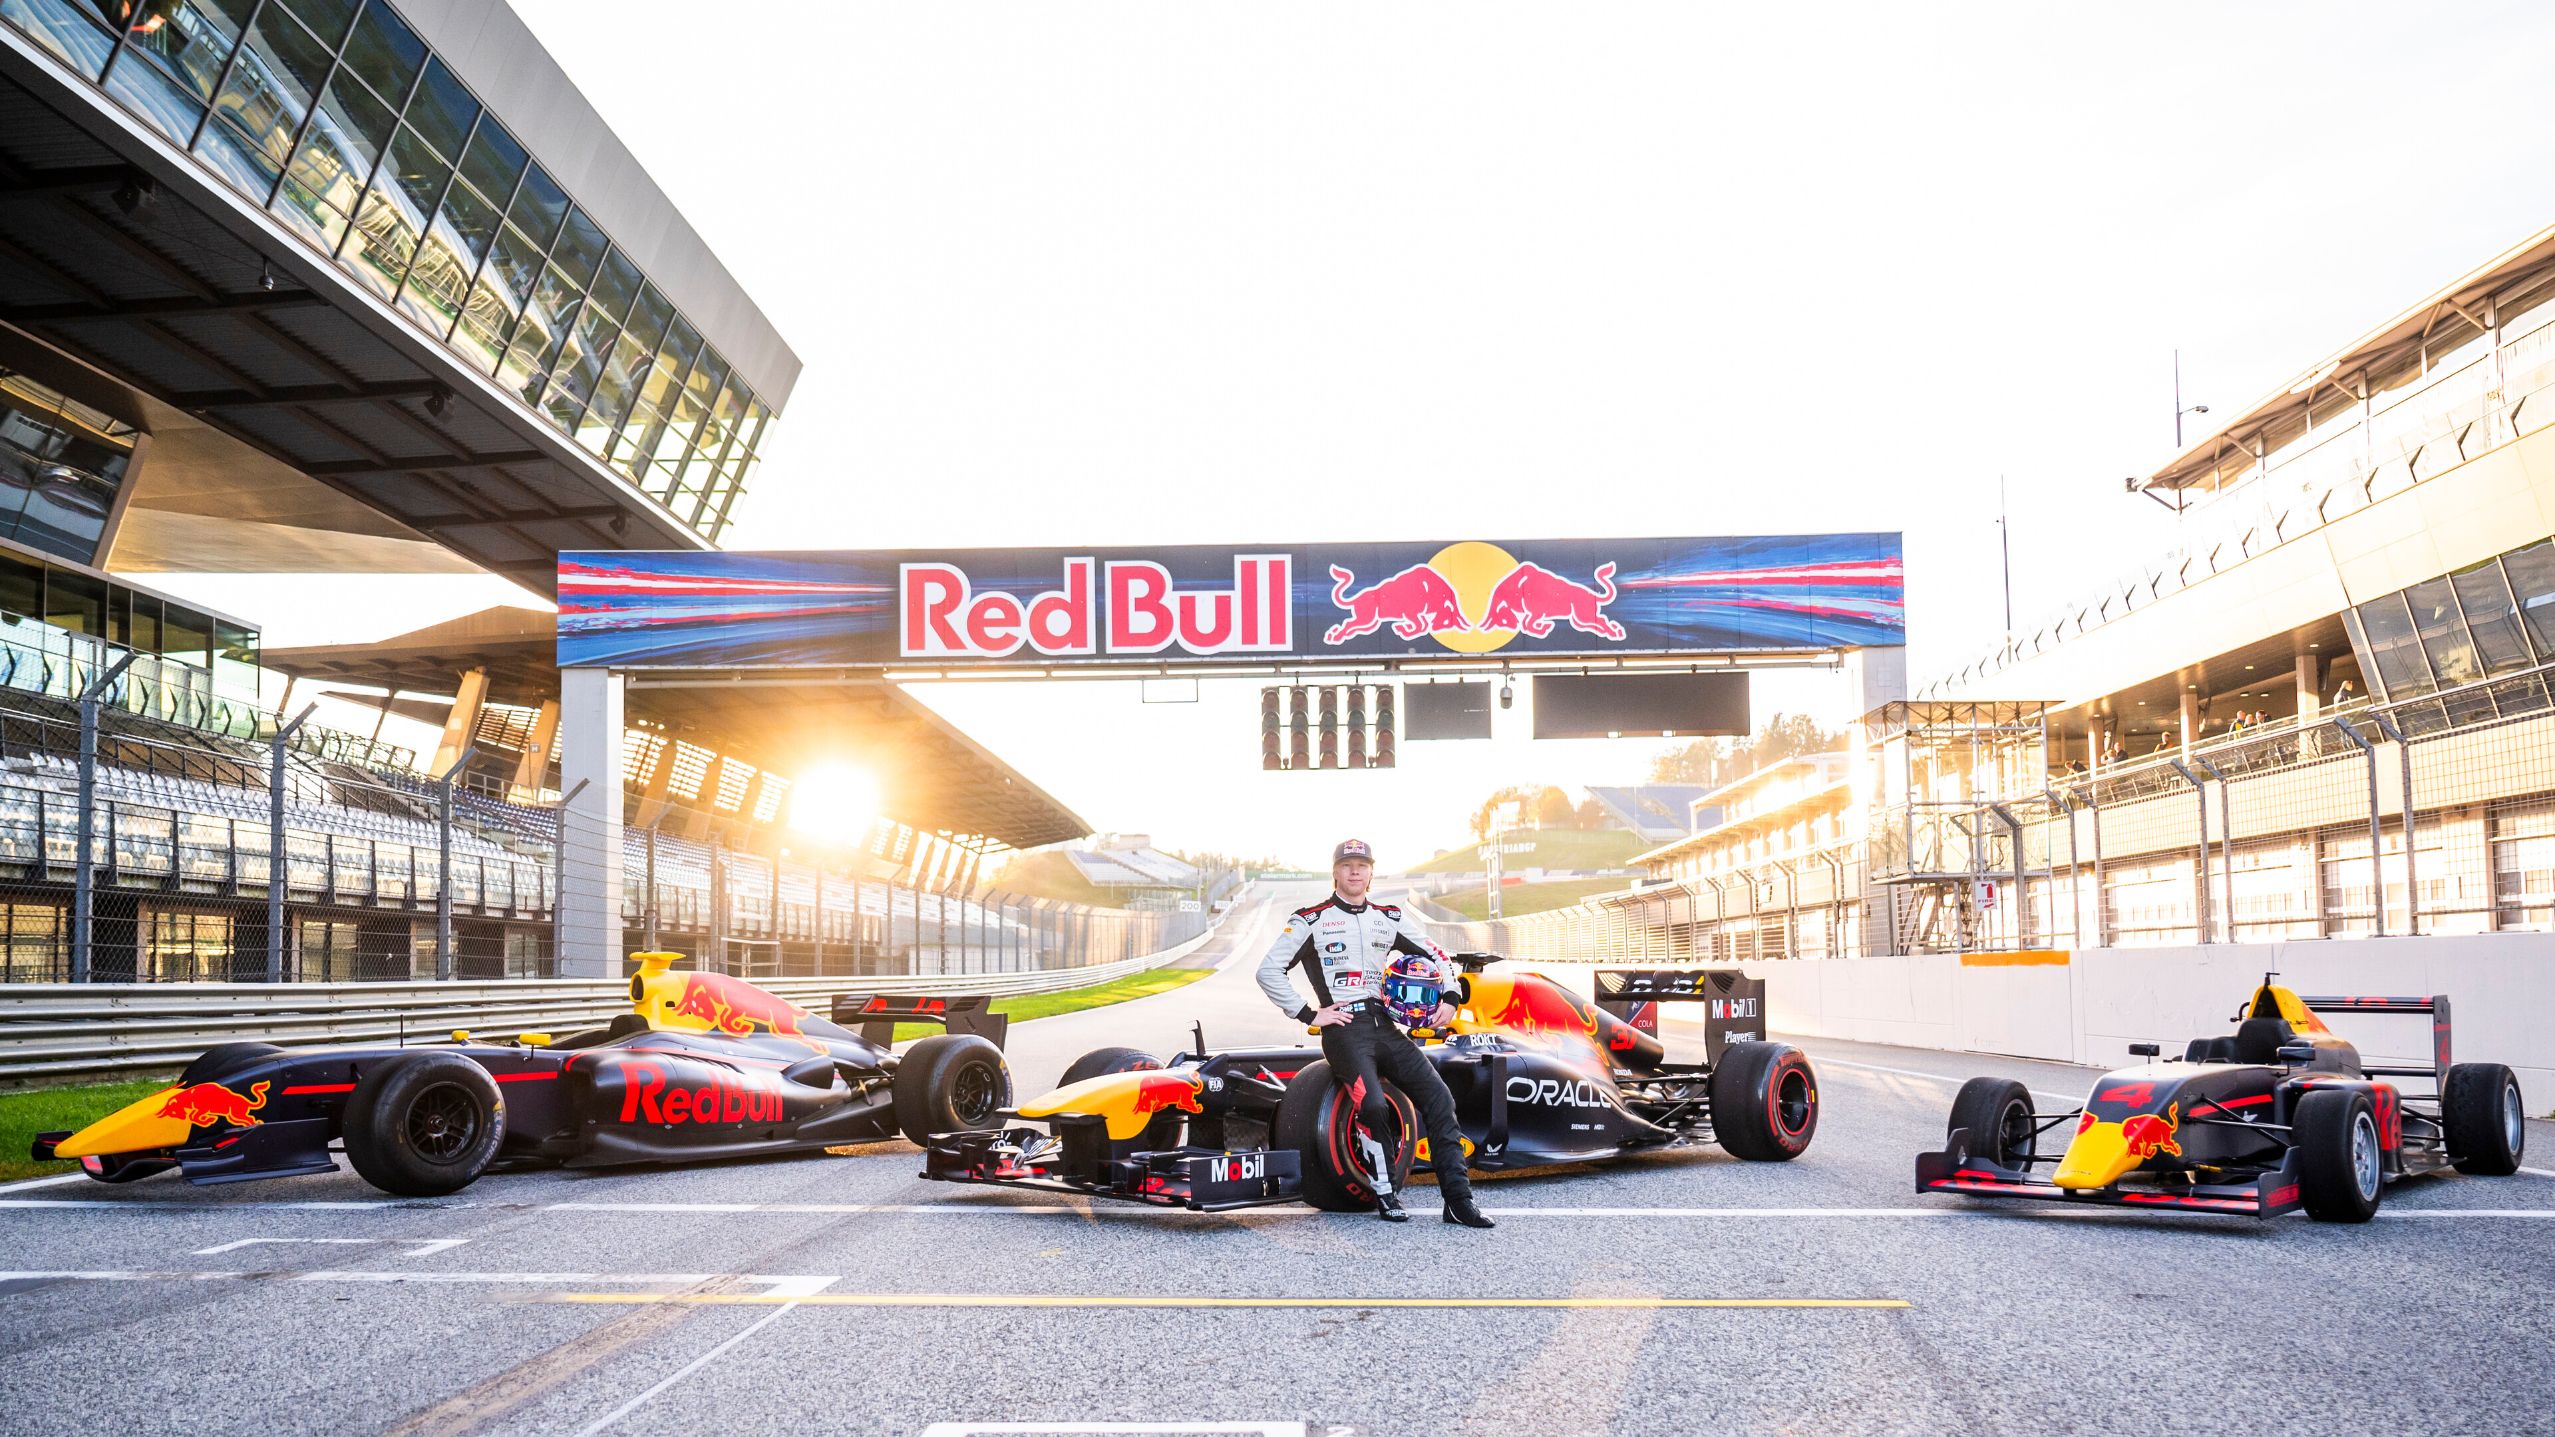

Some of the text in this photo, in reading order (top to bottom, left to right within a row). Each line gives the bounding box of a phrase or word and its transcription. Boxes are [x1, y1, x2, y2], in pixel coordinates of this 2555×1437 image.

[903, 557, 1289, 654] Red Bull
[1181, 902, 1199, 910] 200
[1334, 976, 1361, 987] GR
[1712, 999, 1746, 1019] Mobil
[1638, 1019, 1653, 1028] COLA
[618, 1061, 784, 1124] Red Bull
[1209, 1078, 1223, 1091] FIA
[1506, 1076, 1612, 1109] ORACLE
[2099, 1083, 2157, 1108] 4
[1211, 1154, 1265, 1183] Mobil
